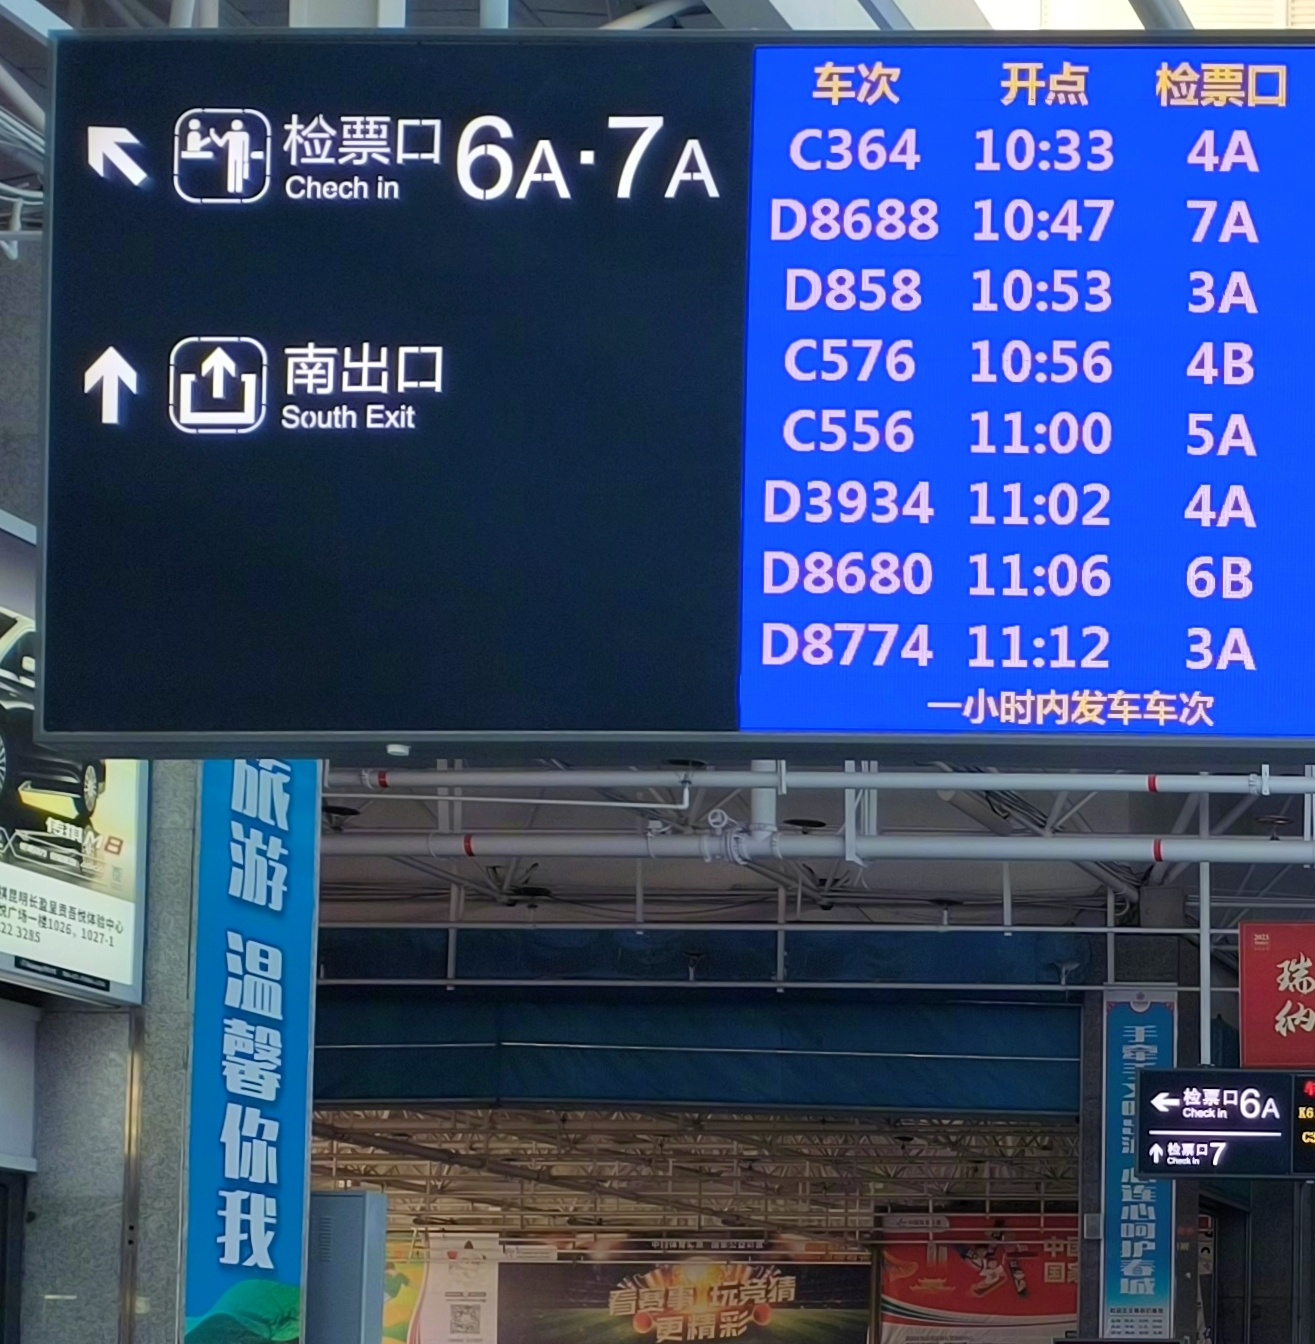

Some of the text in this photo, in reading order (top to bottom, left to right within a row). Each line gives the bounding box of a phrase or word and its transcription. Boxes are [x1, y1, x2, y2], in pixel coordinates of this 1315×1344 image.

[812, 61, 901, 106] 车次
[1000, 61, 1089, 106] 开点
[1155, 61, 1287, 107] 检票口
[283, 114, 441, 166] 检票口
[789, 128, 921, 171] C364
[975, 128, 1114, 172] 10:33
[1187, 129, 1259, 172] 4A
[285, 175, 399, 199] Chech in
[770, 198, 939, 241] D8688
[973, 198, 1115, 242] 10:47
[1186, 200, 1259, 243] 7A
[786, 268, 922, 311] D858
[972, 269, 1112, 313] 10:53
[1188, 270, 1259, 314] 3A
[284, 342, 443, 395] 南出口
[784, 338, 916, 382] C576
[971, 339, 1113, 384] 10:56
[1186, 341, 1254, 385] 4B
[281, 404, 416, 429] South Exit
[783, 409, 914, 453] C556
[970, 410, 1112, 455] 11:00
[1186, 413, 1257, 457] 5A
[764, 479, 935, 524] D3934
[970, 481, 1110, 526] 11:02
[1184, 484, 1257, 528] 4A
[763, 551, 933, 595] D8680
[969, 553, 1111, 597] 11:06
[1186, 555, 1253, 599] 6B
[762, 622, 934, 667] D8774
[968, 624, 1109, 669] 11:12
[1185, 627, 1257, 671] 3A
[927, 688, 1215, 727] 一小时内发车车次
[216, 930, 283, 1271] 温馨你我
[1182, 1107, 1228, 1121] Check in
[1183, 1087, 1281, 1121] 检票口 6A
[1167, 1142, 1227, 1166] 检票口 7
[655, 1309, 753, 1344] 更精彩
